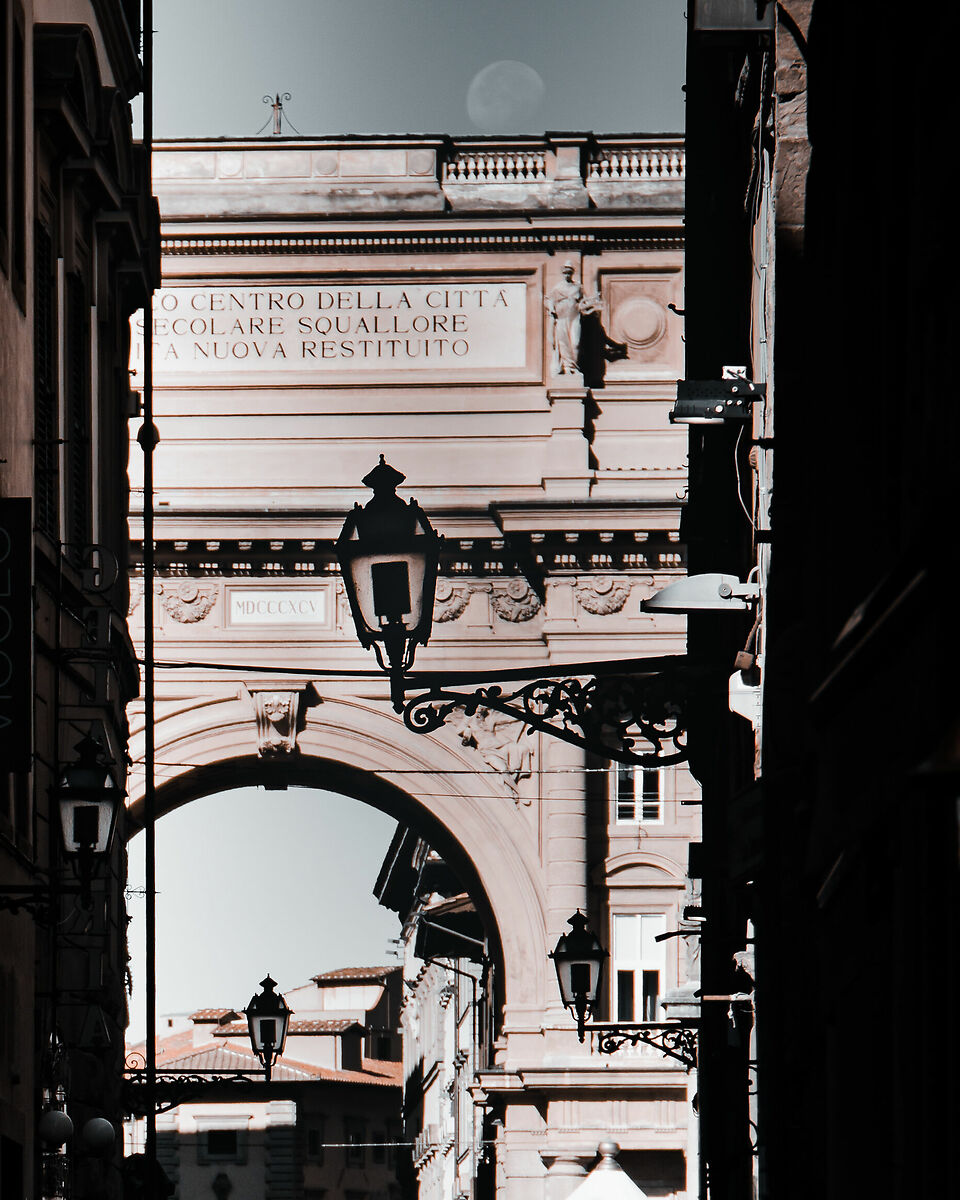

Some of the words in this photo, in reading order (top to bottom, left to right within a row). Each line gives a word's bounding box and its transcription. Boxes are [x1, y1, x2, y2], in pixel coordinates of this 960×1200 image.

[191, 292, 305, 312] CENTRO
[317, 291, 412, 310] DELLA
[298, 314, 470, 336] SQUALLORE
[193, 341, 288, 360] NUOVA
[301, 338, 471, 359] RESTITUITO
[235, 599, 318, 615] MDCCCXCV
